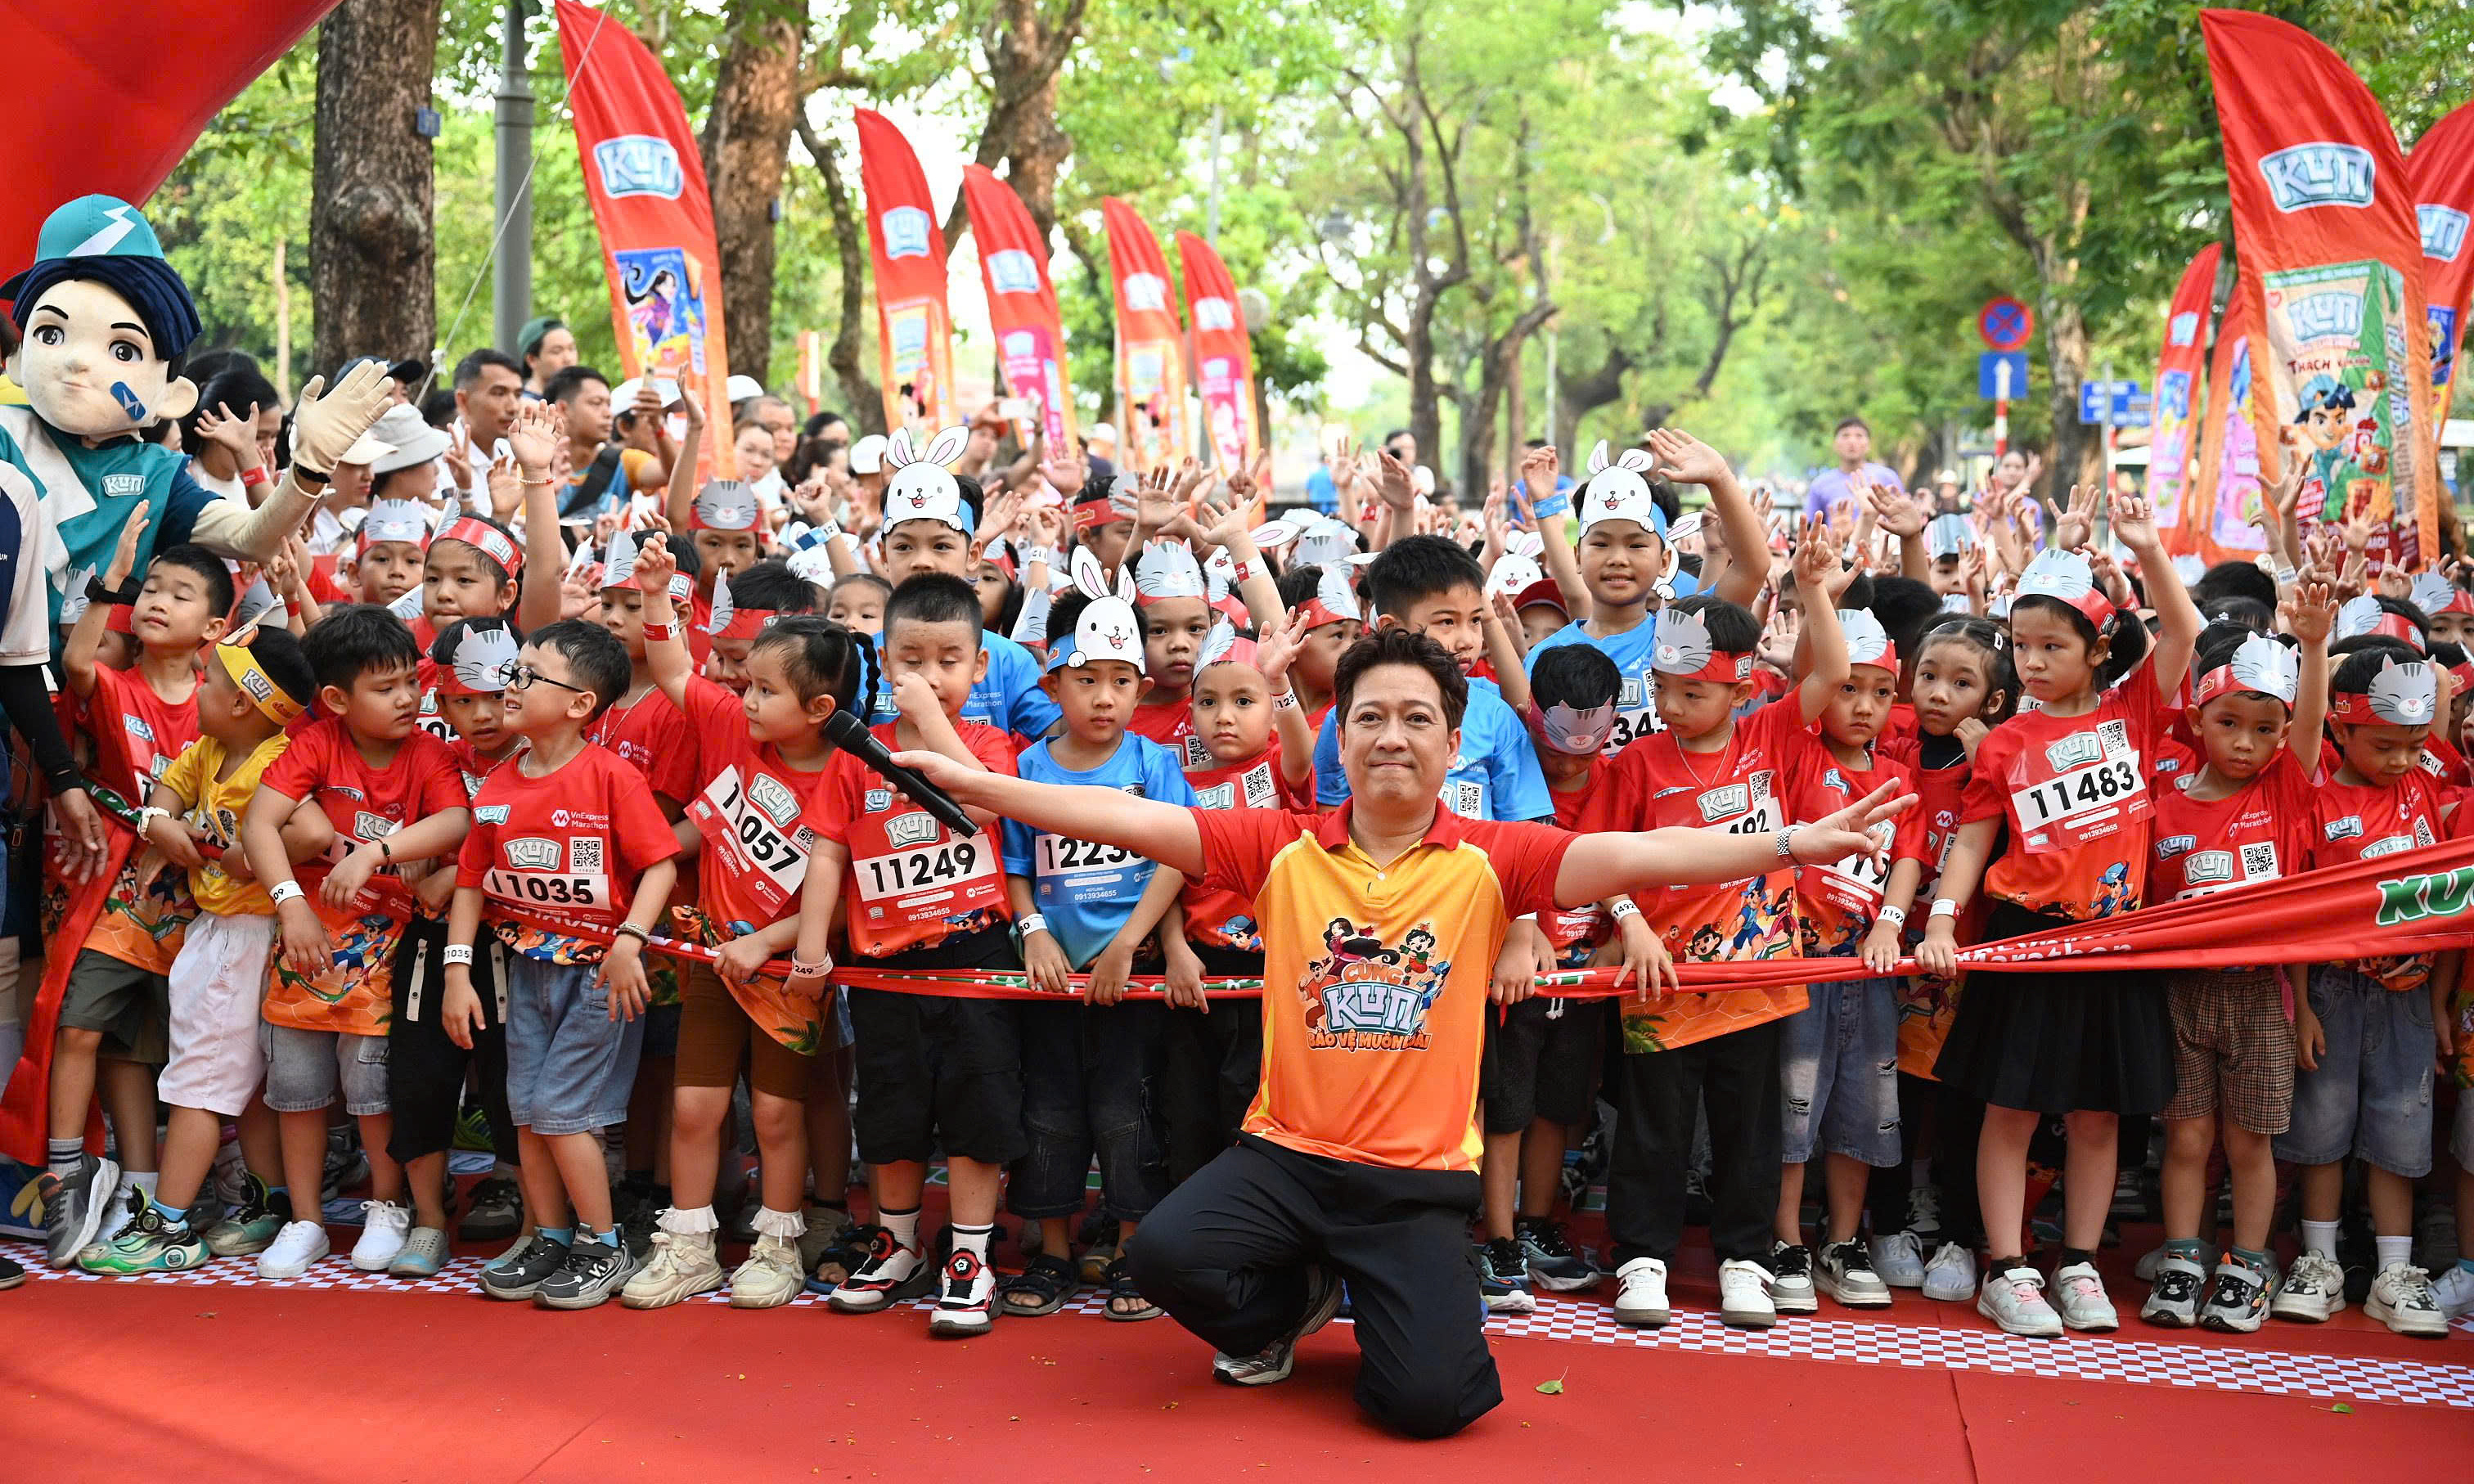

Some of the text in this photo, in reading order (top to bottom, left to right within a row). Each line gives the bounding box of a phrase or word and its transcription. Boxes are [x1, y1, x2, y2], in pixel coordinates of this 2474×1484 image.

[600, 141, 679, 191] KUN
[2263, 147, 2371, 205] KUN
[2290, 293, 2362, 339] KUN
[104, 476, 143, 494] KUN
[669, 575, 688, 596] KU
[969, 691, 1002, 700] nExpress
[2050, 735, 2101, 768] KUN
[750, 777, 801, 825] KUN
[1700, 787, 1748, 818] KUN
[2031, 761, 2134, 819] 11483
[571, 811, 609, 821] VnExpress
[572, 821, 609, 830] Marathon
[722, 781, 801, 873] 11057
[888, 815, 939, 845] KUN
[506, 840, 559, 867] KUN
[2157, 836, 2196, 857] KUN
[870, 843, 976, 893] 11249
[2185, 853, 2232, 881] KUN
[492, 870, 594, 904] 11035
[2376, 866, 2474, 926] KU
[908, 906, 951, 921] 0913934655
[1343, 959, 1404, 983] CÙNG
[1325, 985, 1419, 1031] KUN
[1307, 1028, 1337, 1049] BẢO
[1338, 1028, 1357, 1052] VỆ
[1358, 1032, 1404, 1050] MUÔN
